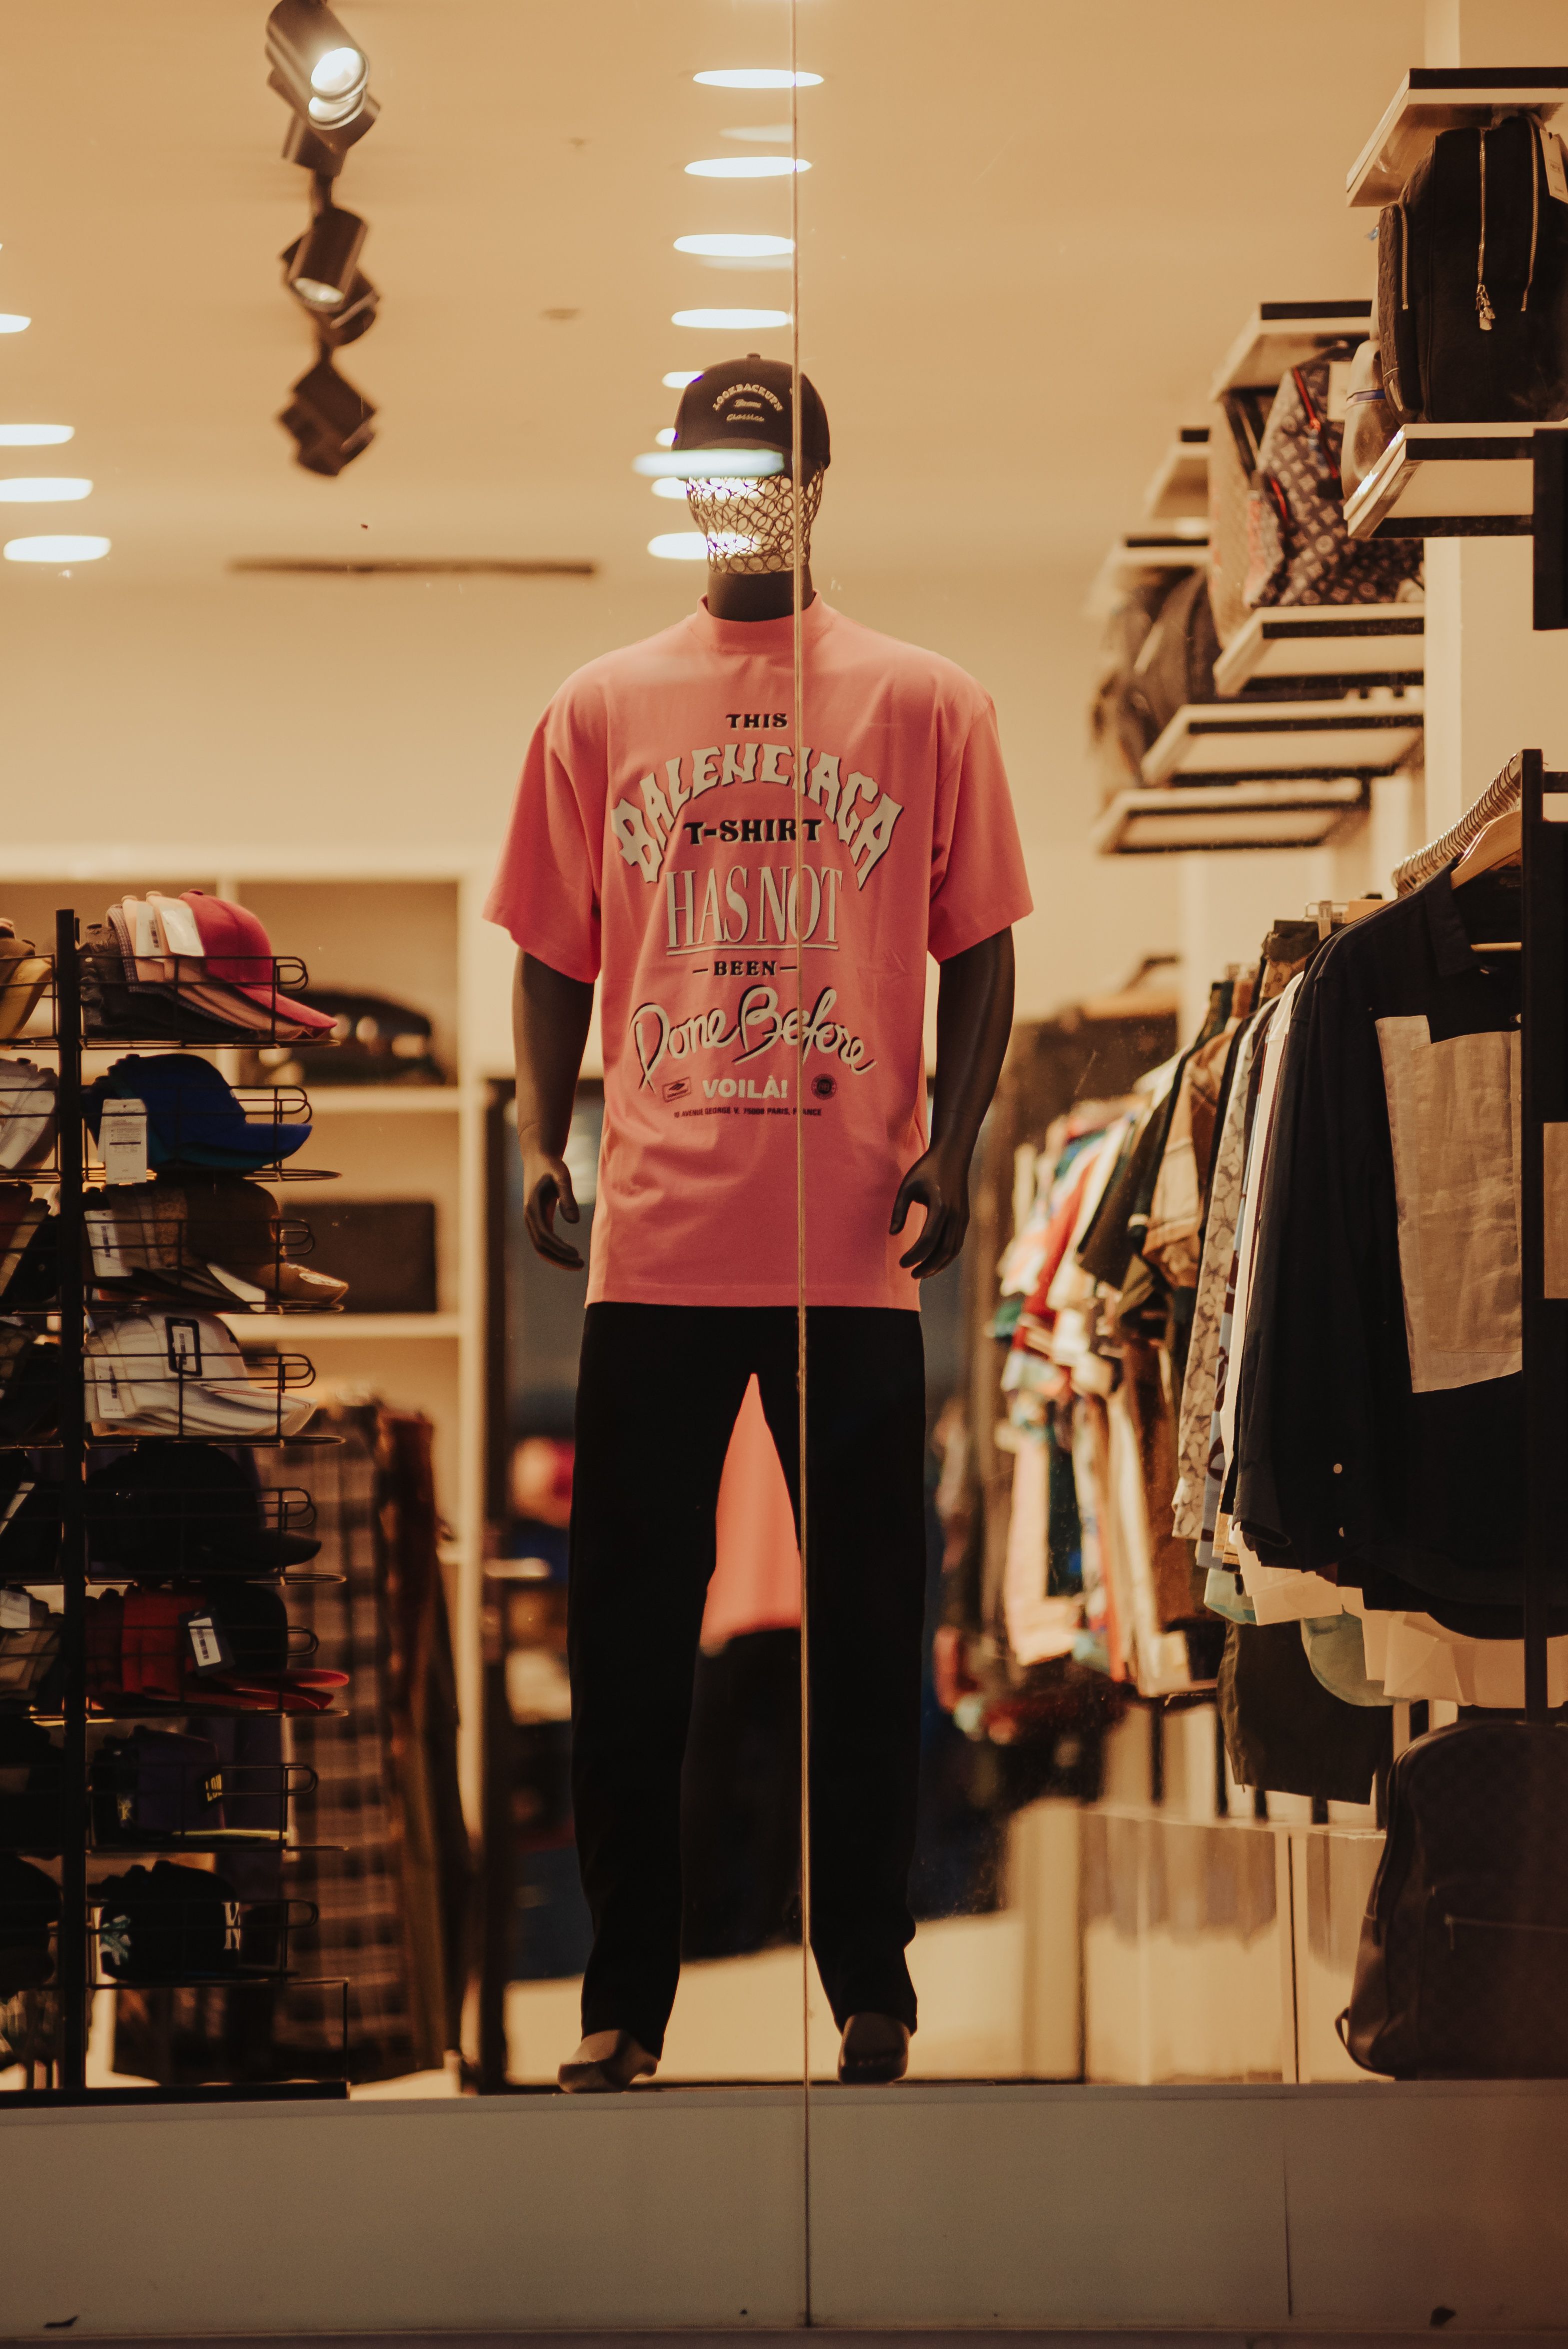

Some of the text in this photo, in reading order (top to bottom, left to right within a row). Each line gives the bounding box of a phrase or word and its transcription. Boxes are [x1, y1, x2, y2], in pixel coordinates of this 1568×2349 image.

[726, 713, 787, 728] THIS
[611, 743, 904, 891] BALENCIAGA
[683, 818, 824, 844] T-SHIRT
[665, 864, 843, 948] HAS NOT
[713, 960, 778, 976] BEEN
[629, 984, 877, 1095] Done Before
[681, 1108, 703, 1117] AVENUE
[704, 1106, 731, 1115] GEORGE
[792, 1107, 822, 1116] FANCE
